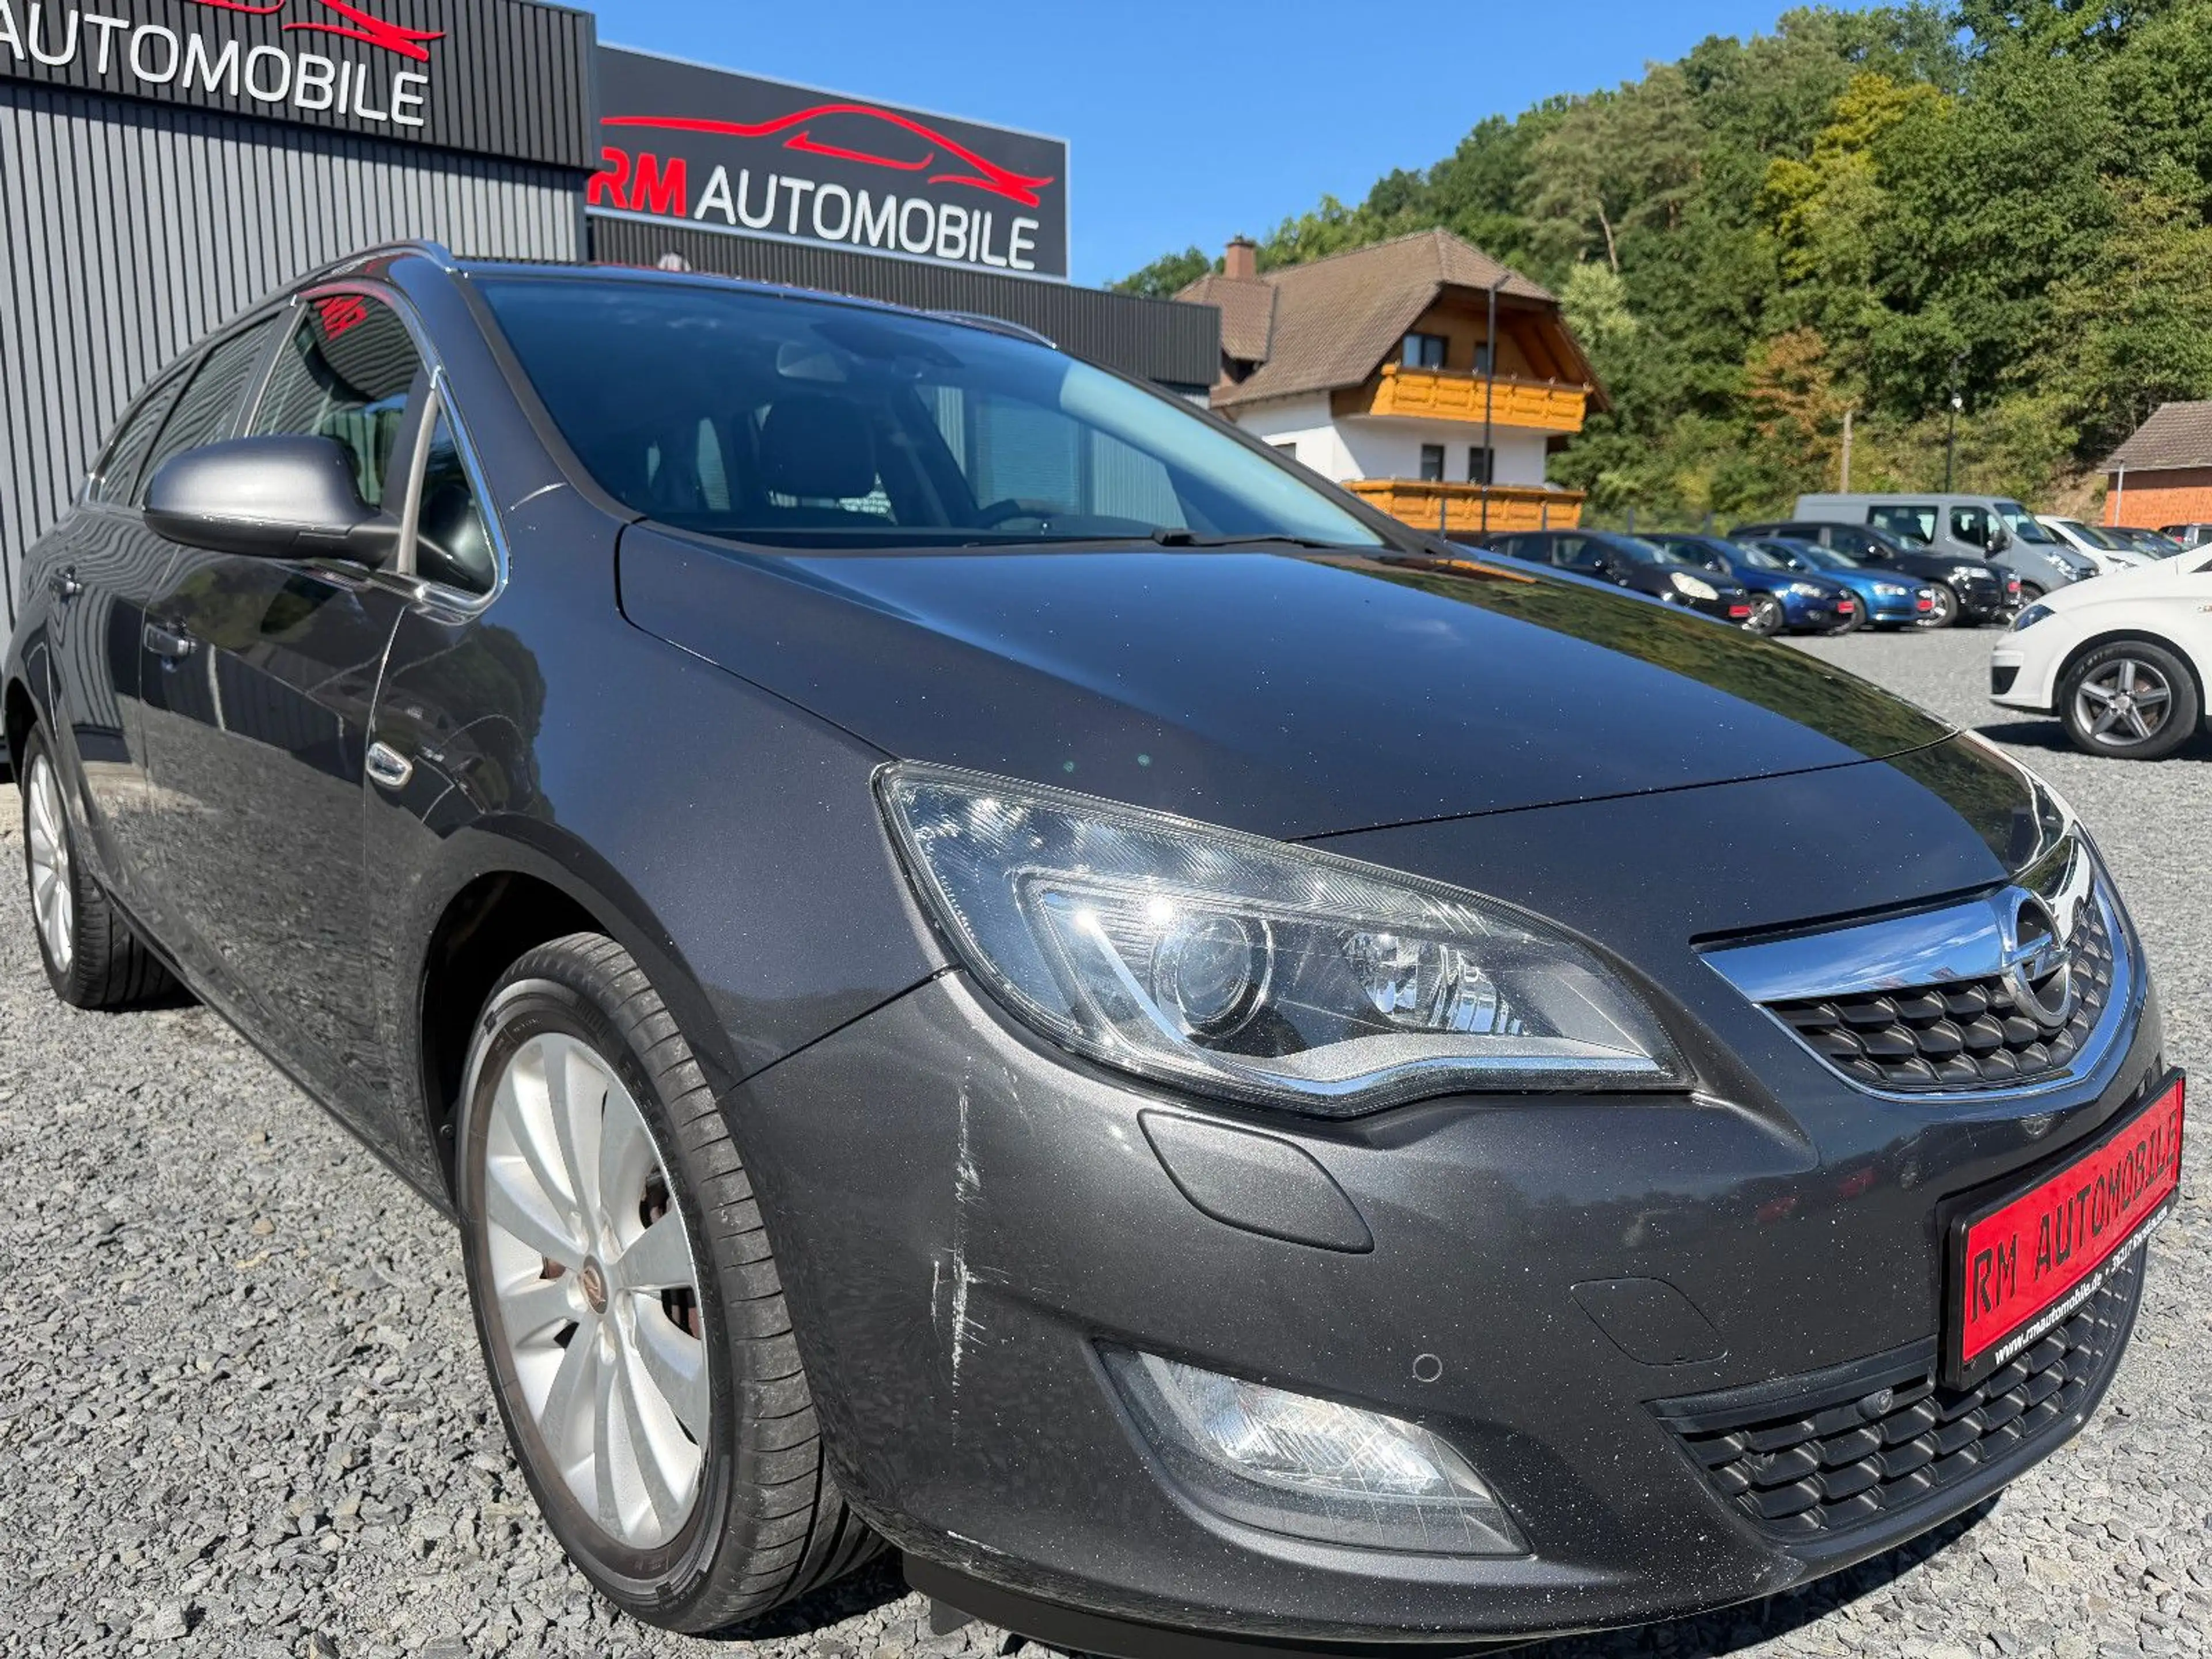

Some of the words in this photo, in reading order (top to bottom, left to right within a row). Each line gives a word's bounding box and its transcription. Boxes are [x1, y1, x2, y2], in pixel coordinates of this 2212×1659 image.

[587, 146, 687, 217] RM
[693, 164, 1039, 271] AUTOMOBILE
[1971, 1232, 2018, 1324] RM
[2035, 1109, 2176, 1281] AUTOMOBILE
[1994, 1271, 2103, 1366] www.rmautomobile.de
